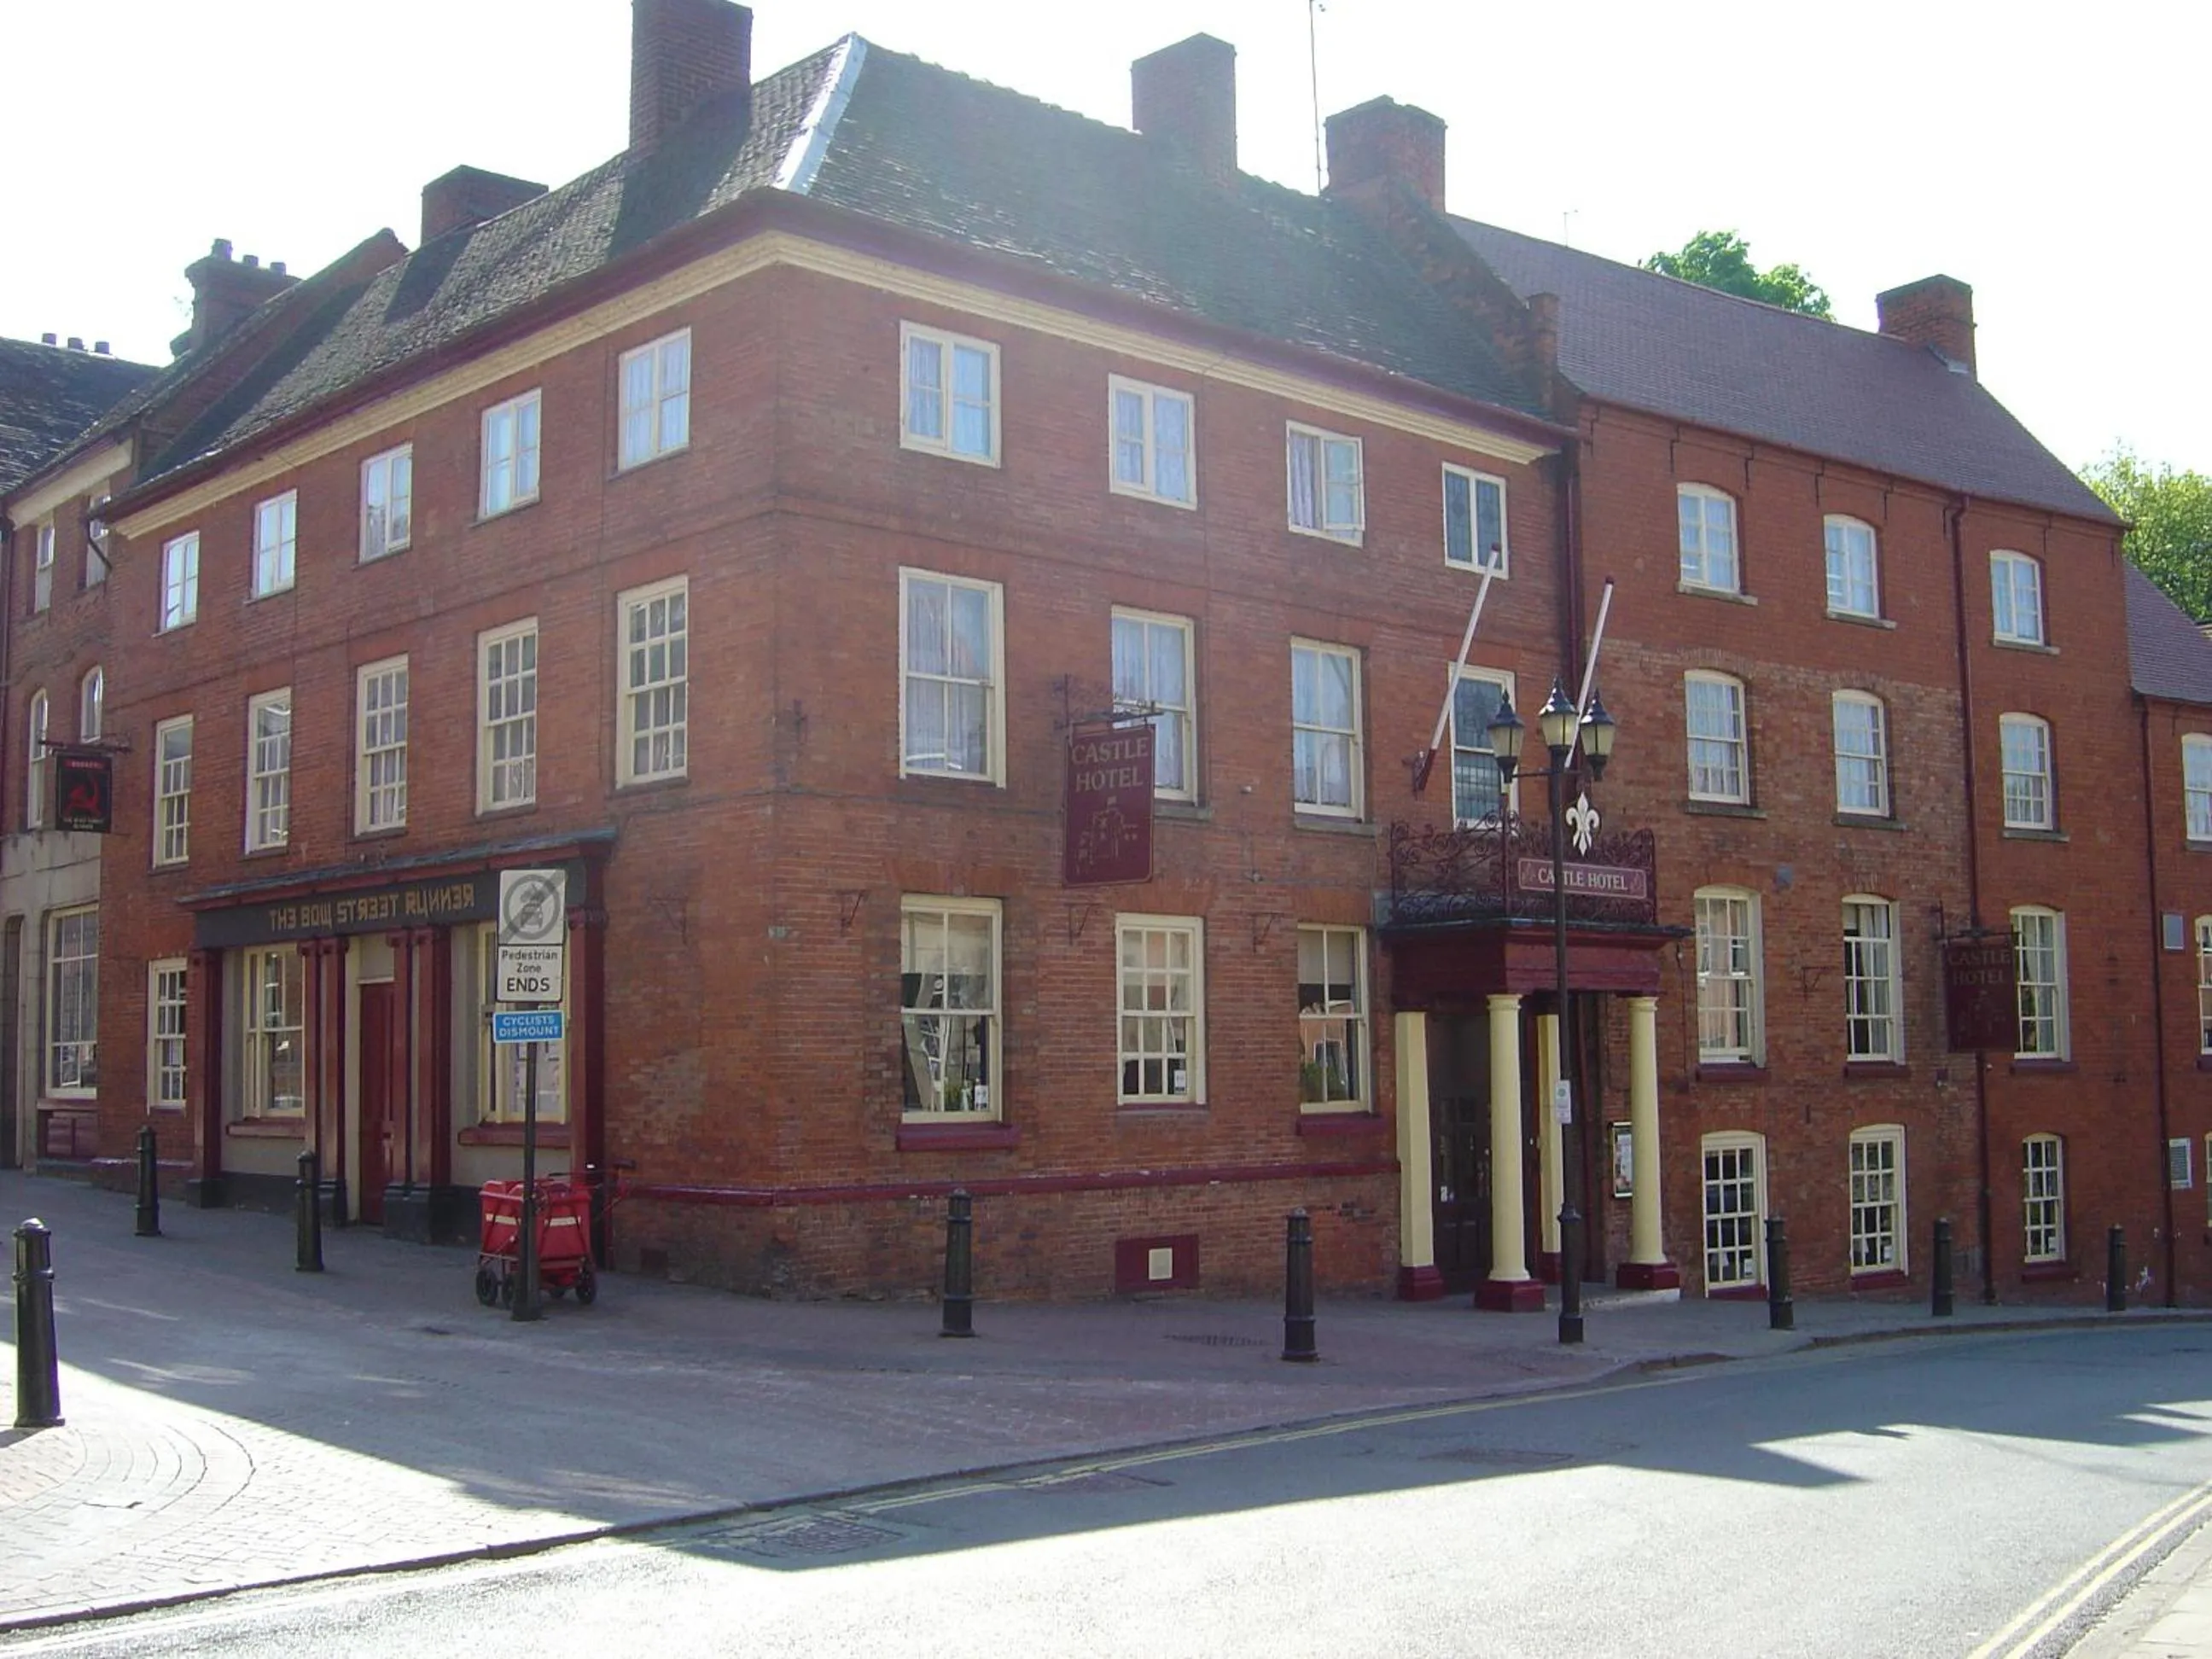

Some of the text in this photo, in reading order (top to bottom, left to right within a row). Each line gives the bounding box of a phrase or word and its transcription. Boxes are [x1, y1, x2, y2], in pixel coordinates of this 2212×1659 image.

[1072, 737, 1150, 765] CASTLE
[1075, 767, 1144, 792] HOTEL
[1538, 867, 1628, 890] CATLE HOTEL
[502, 950, 558, 960] Pedestrian
[1948, 949, 2011, 965] CASTLE
[517, 962, 542, 973] Zone
[507, 977, 550, 992] ENDS
[1953, 969, 2005, 986] HOTEL
[503, 1015, 555, 1026] CYCLISTS
[499, 1026, 559, 1038] DISMOUNT
